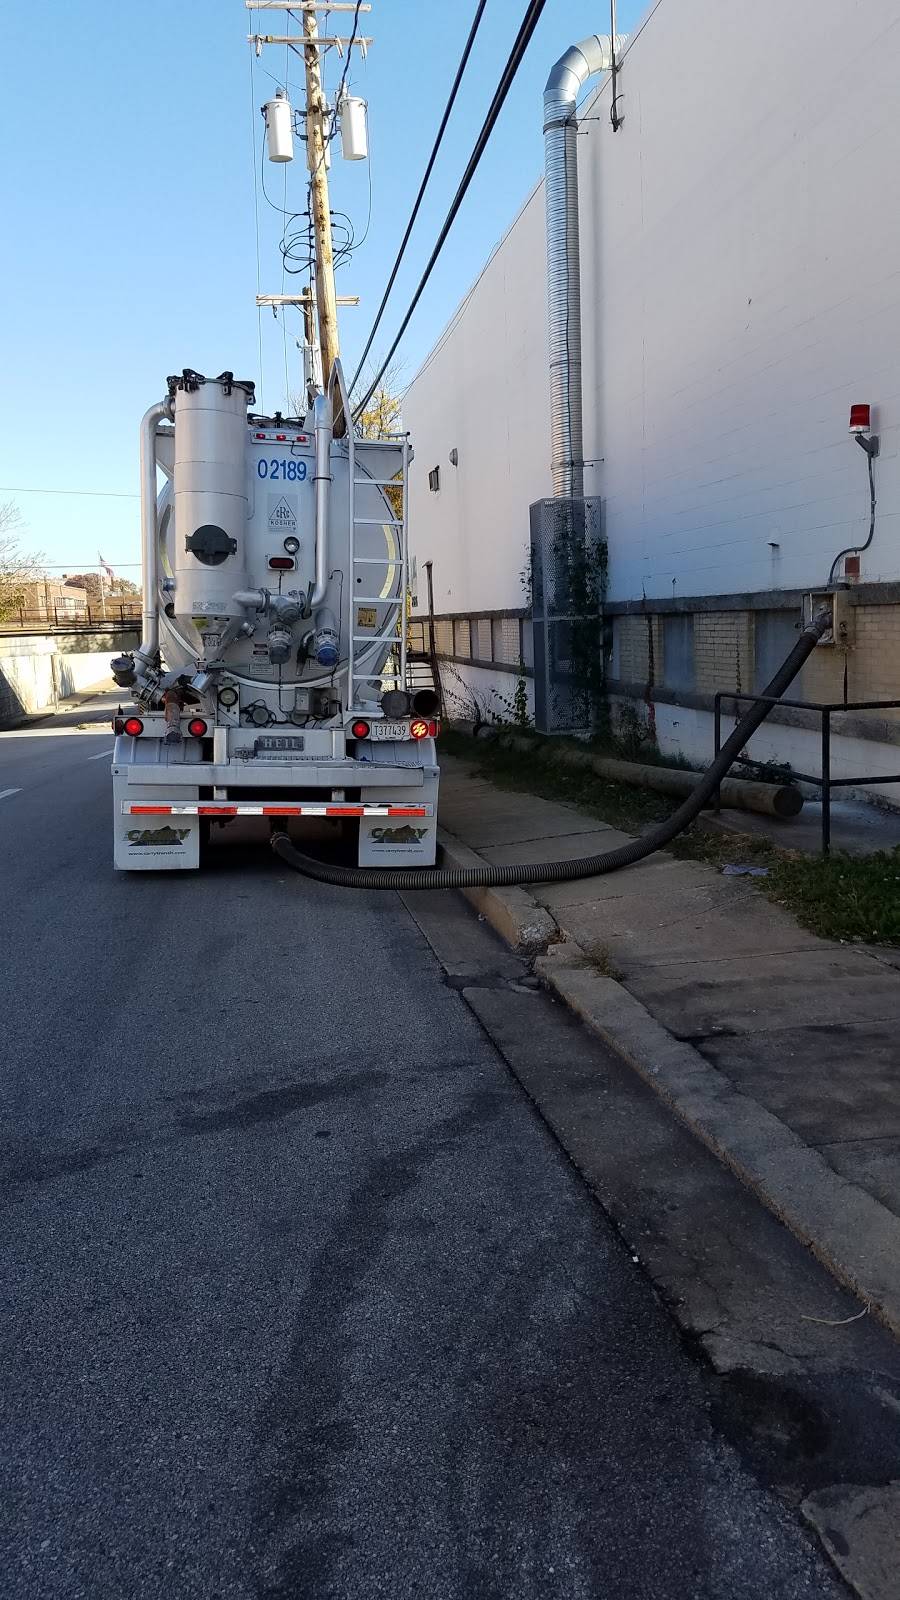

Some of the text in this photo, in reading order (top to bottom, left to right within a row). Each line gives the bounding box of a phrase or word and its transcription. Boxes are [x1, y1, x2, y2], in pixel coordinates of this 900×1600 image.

[257, 459, 307, 481] 02189
[374, 725, 406, 736] T377439
[264, 738, 298, 749] HEIL
